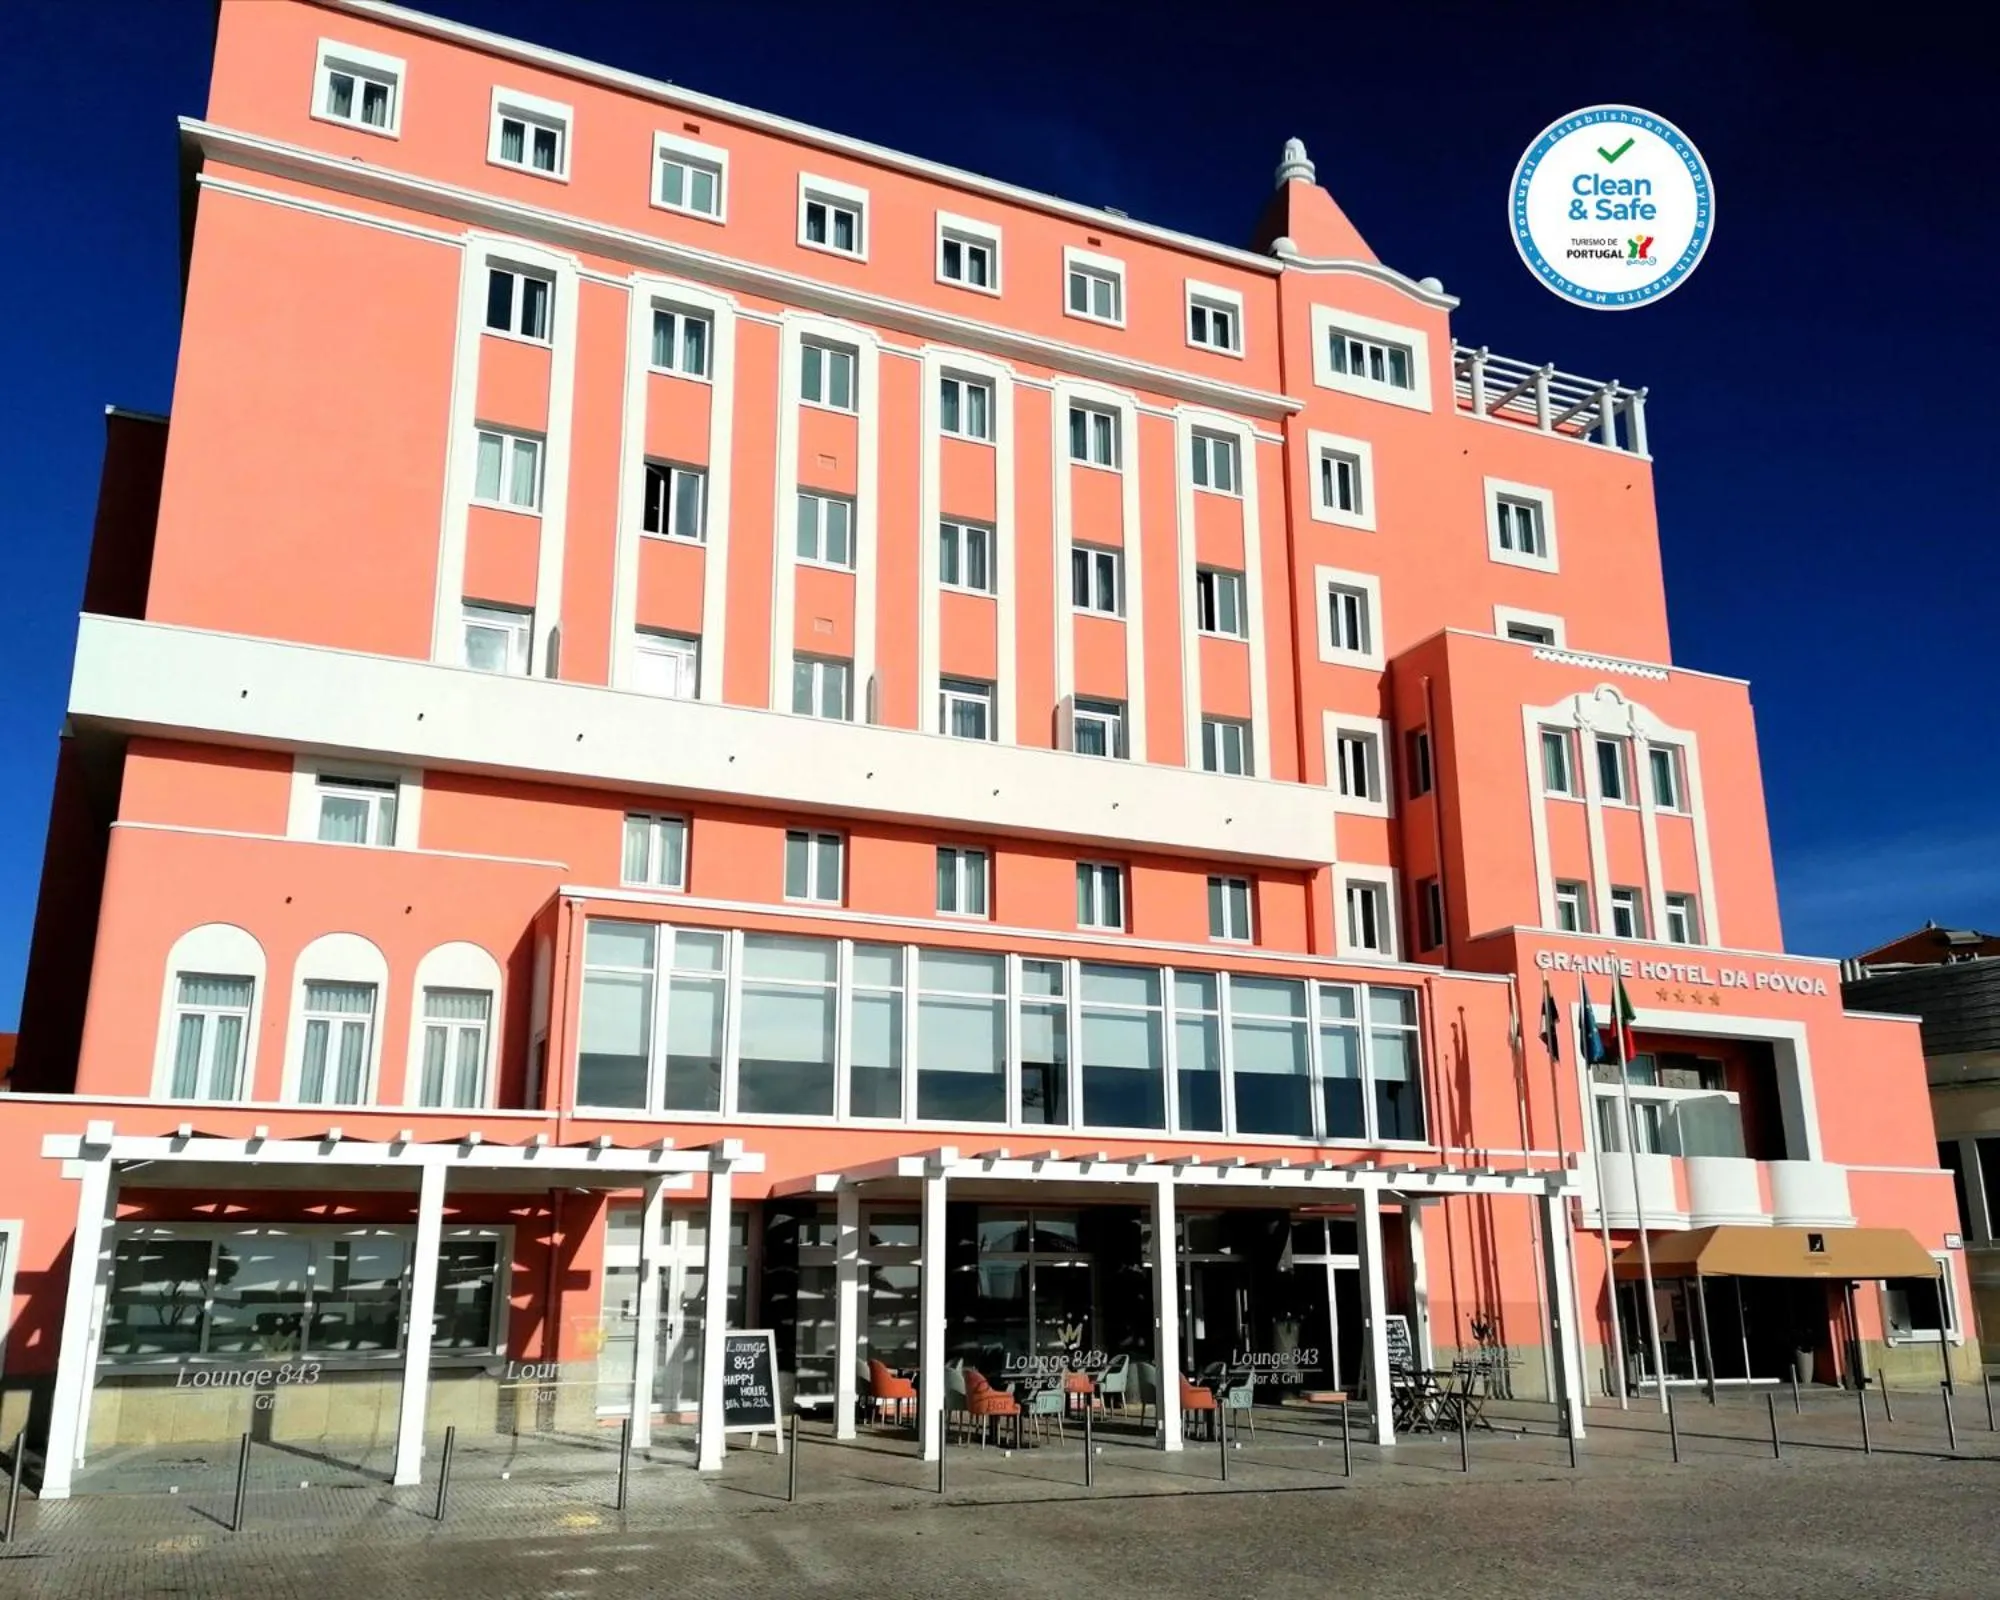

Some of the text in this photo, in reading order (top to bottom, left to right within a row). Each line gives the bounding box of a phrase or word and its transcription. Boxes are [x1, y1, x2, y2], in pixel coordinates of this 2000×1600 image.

[1639, 960, 1715, 986] HOTEL
[1718, 968, 1749, 989] DA
[1753, 970, 1828, 997] PÓVOA
[726, 1339, 767, 1358] Lounge
[1232, 1347, 1320, 1369] Lounge 843
[733, 1355, 756, 1371] 843
[1005, 1350, 1103, 1372] Lounge 843
[275, 1362, 322, 1386] 843
[1024, 1377, 1043, 1389] Bar
[1047, 1376, 1057, 1389] &
[1270, 1372, 1280, 1385] &
[1281, 1372, 1304, 1385] Grill
